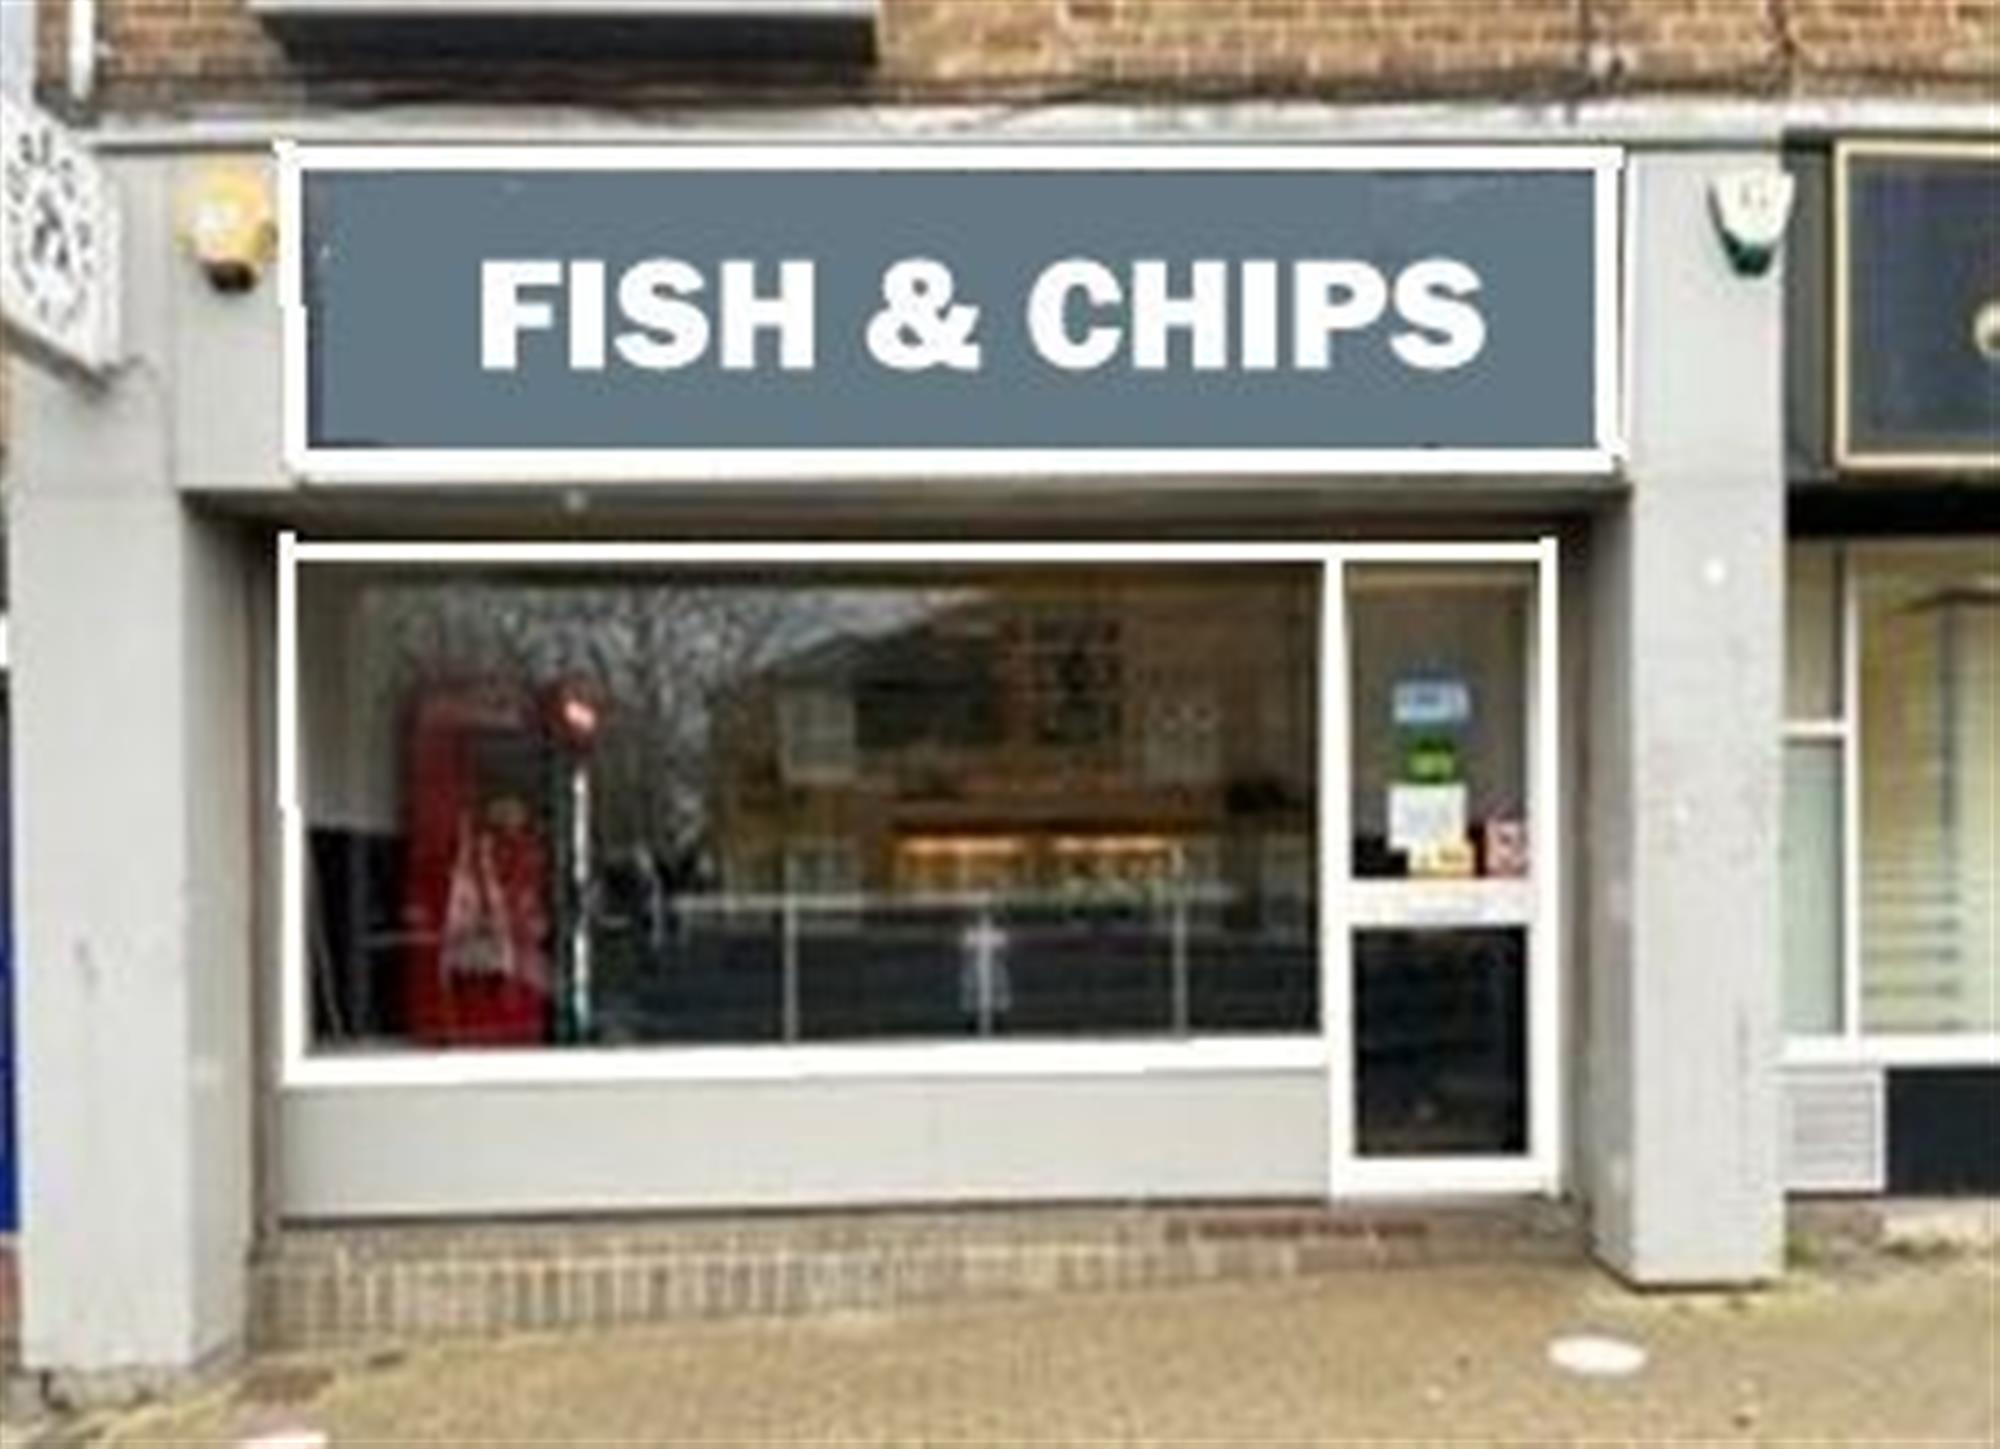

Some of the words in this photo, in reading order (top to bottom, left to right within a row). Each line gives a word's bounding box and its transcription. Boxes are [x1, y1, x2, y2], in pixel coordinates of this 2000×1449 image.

[481, 259, 815, 370] FISH
[866, 259, 980, 370] &
[1027, 259, 1486, 370] CHIPS
